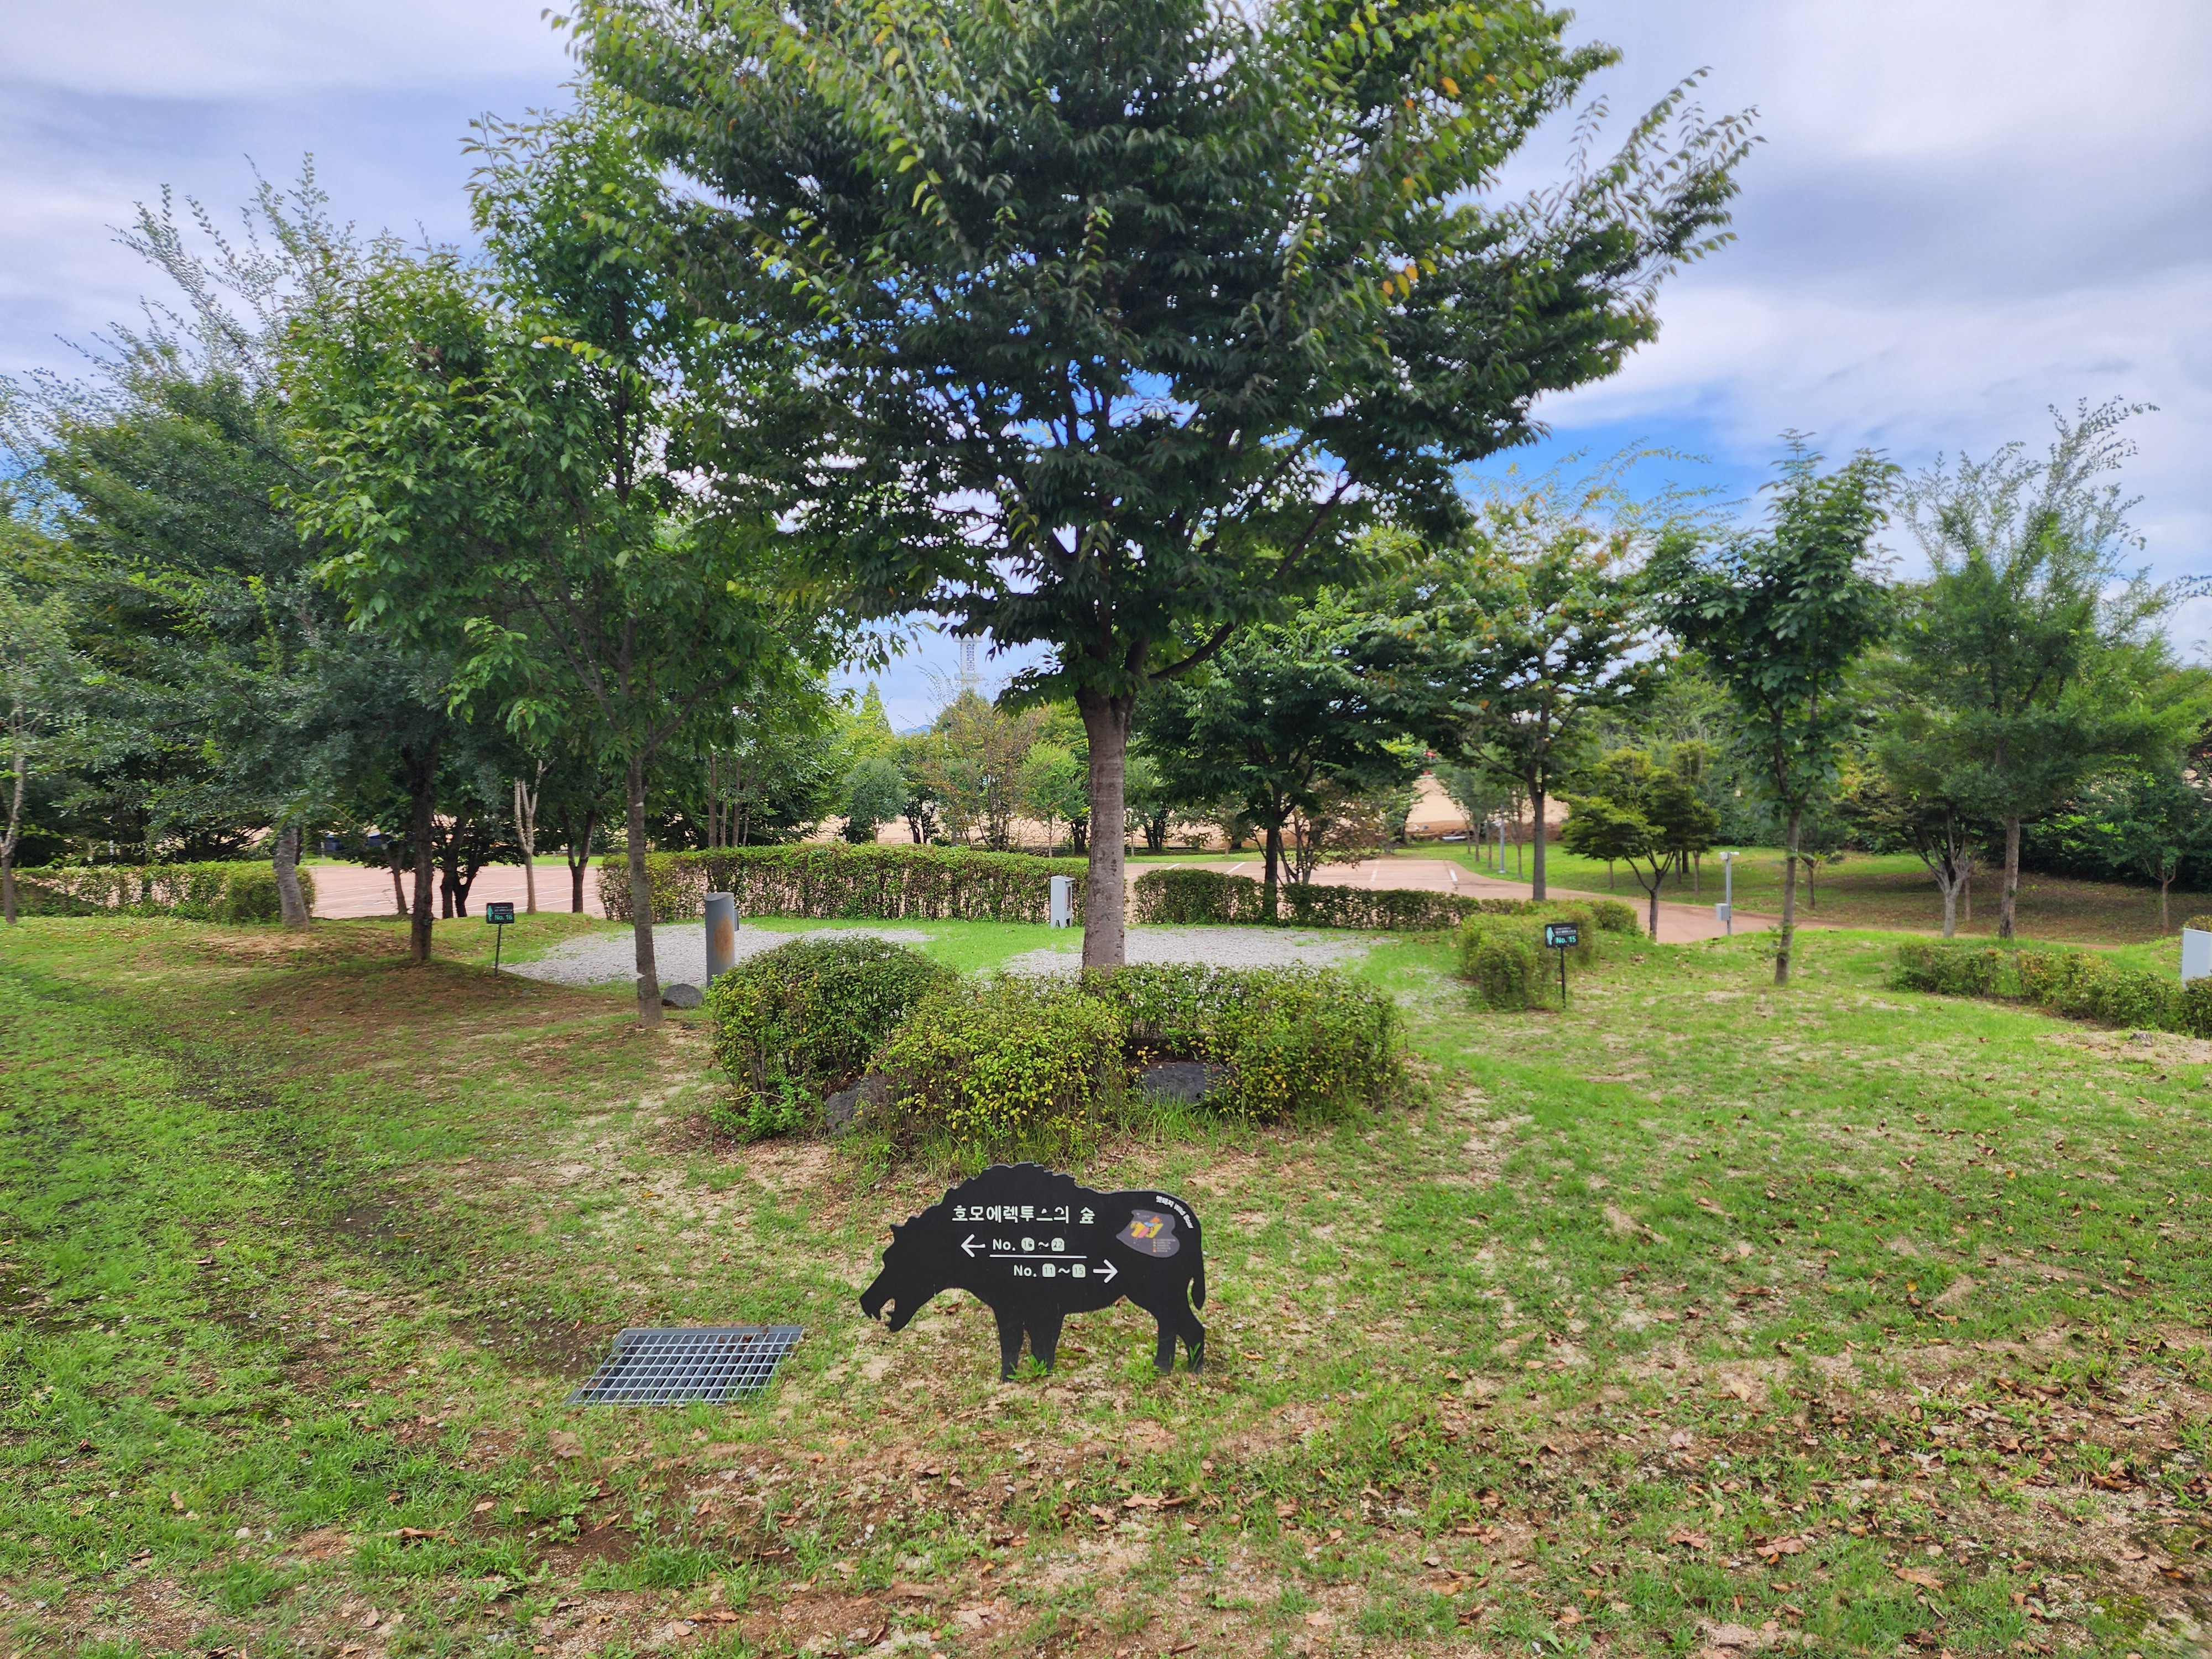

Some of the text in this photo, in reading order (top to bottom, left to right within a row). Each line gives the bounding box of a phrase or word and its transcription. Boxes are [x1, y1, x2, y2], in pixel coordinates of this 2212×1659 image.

[952, 1205, 1095, 1224] 호모에렉투스의 숲
[993, 1238, 1016, 1251] No.
[1014, 1265, 1037, 1277] No.
